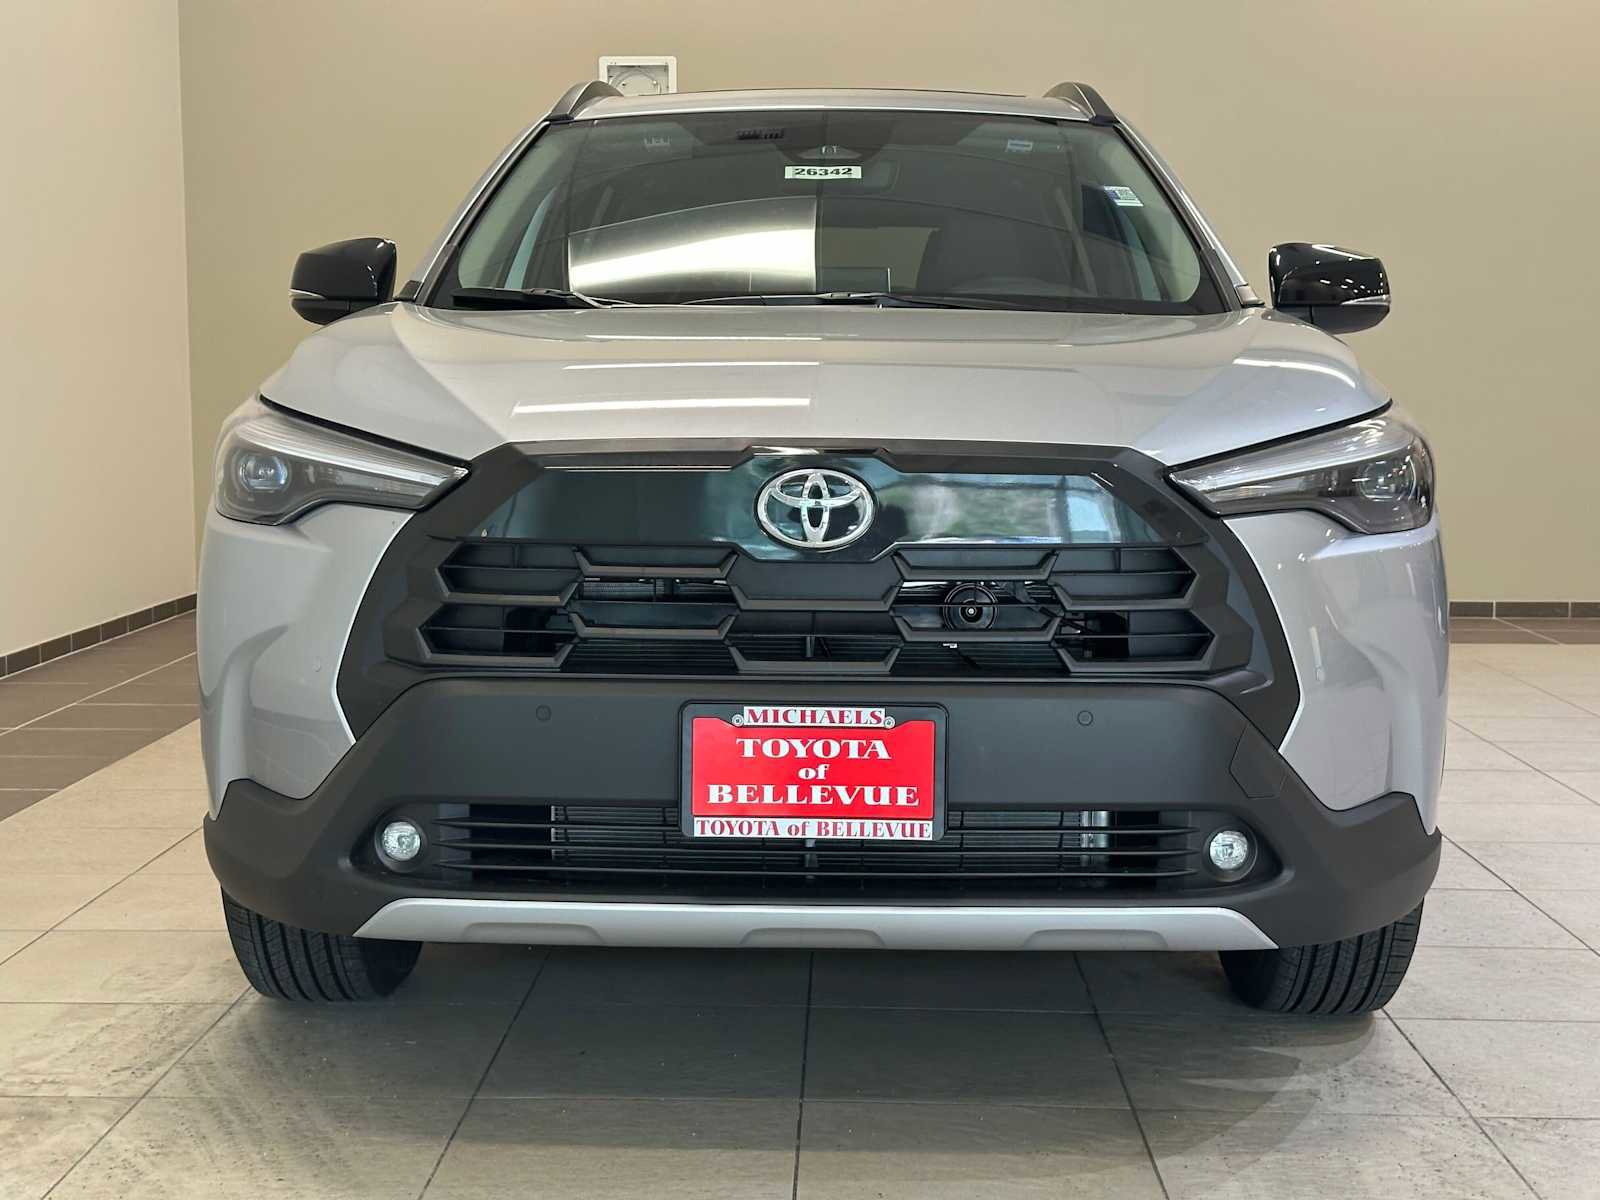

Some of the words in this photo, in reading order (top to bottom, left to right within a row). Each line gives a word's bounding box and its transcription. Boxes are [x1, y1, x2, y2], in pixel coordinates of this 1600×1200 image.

[794, 167, 853, 176] 26342
[746, 708, 883, 725] MICHAELS
[736, 738, 891, 760] TOYOTA
[798, 764, 829, 780] of
[707, 784, 920, 806] BELLEVUE
[696, 819, 780, 836] TOYOTA
[786, 821, 808, 836] of
[817, 821, 931, 838] BELLEVUE
